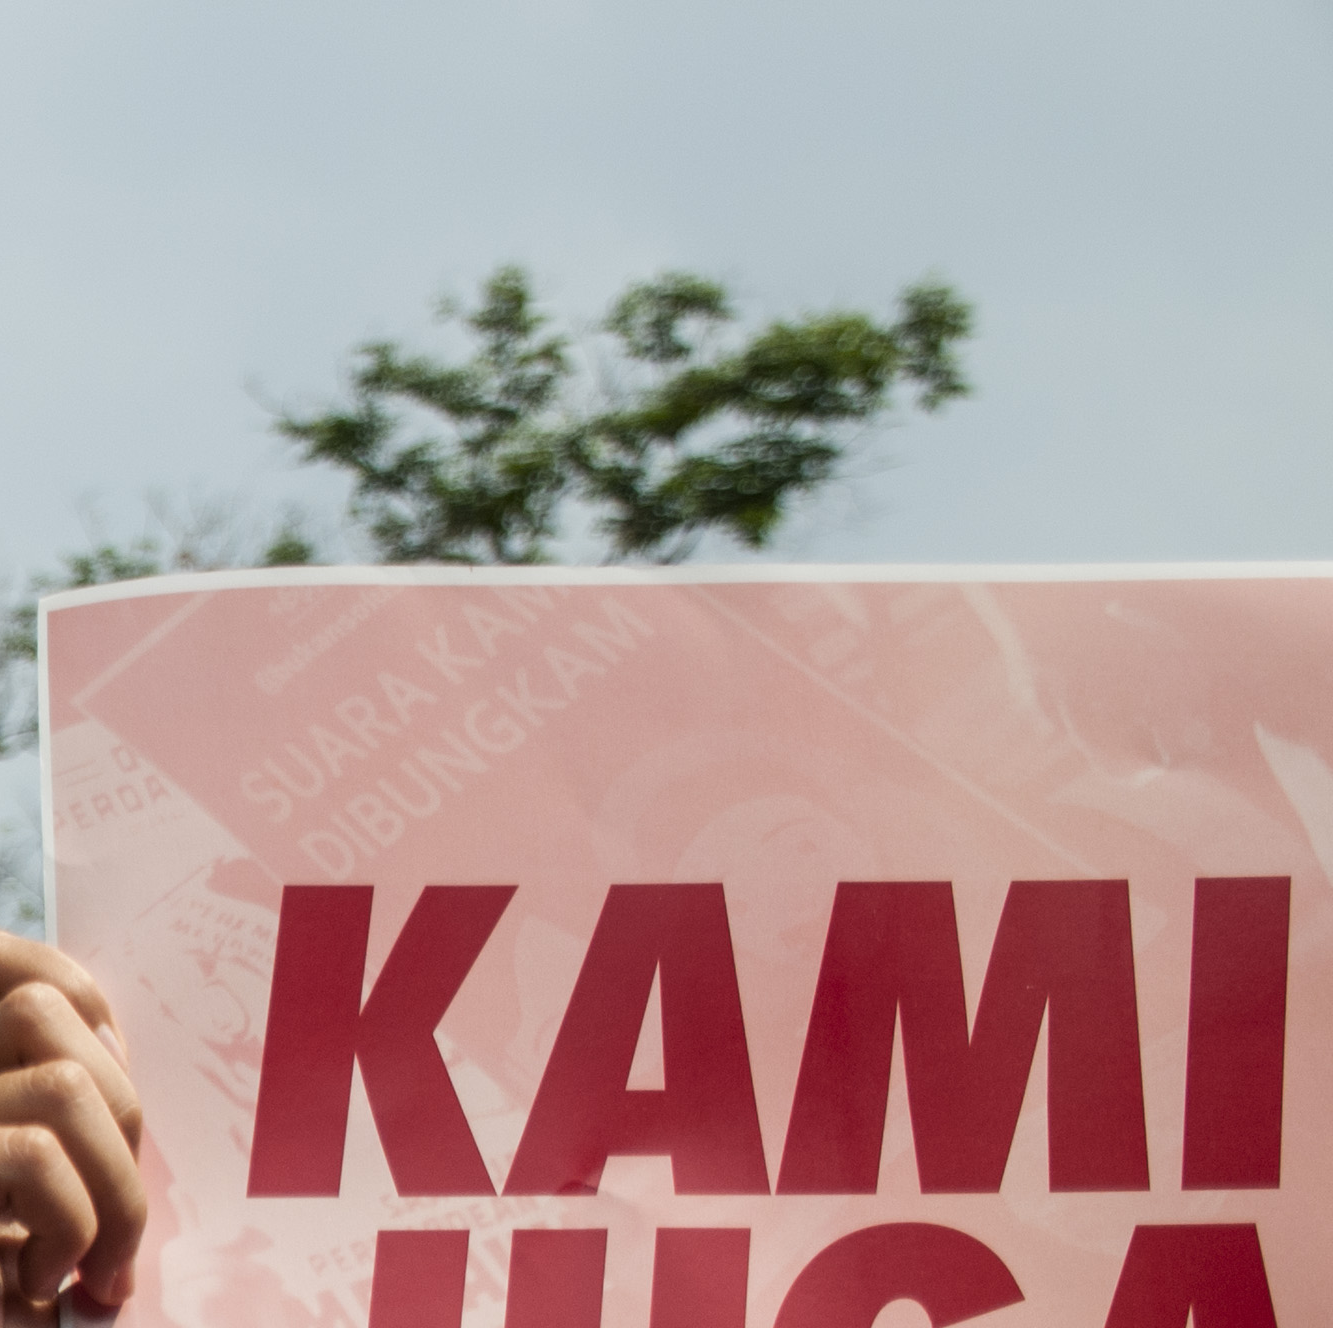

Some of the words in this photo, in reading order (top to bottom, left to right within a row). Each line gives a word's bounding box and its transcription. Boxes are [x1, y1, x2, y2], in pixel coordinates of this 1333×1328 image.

[240, 671, 439, 824] SUARA
[414, 586, 572, 686] KAM
[298, 596, 655, 883] DIBUNGKAM
[246, 876, 1292, 1199] KAMI
